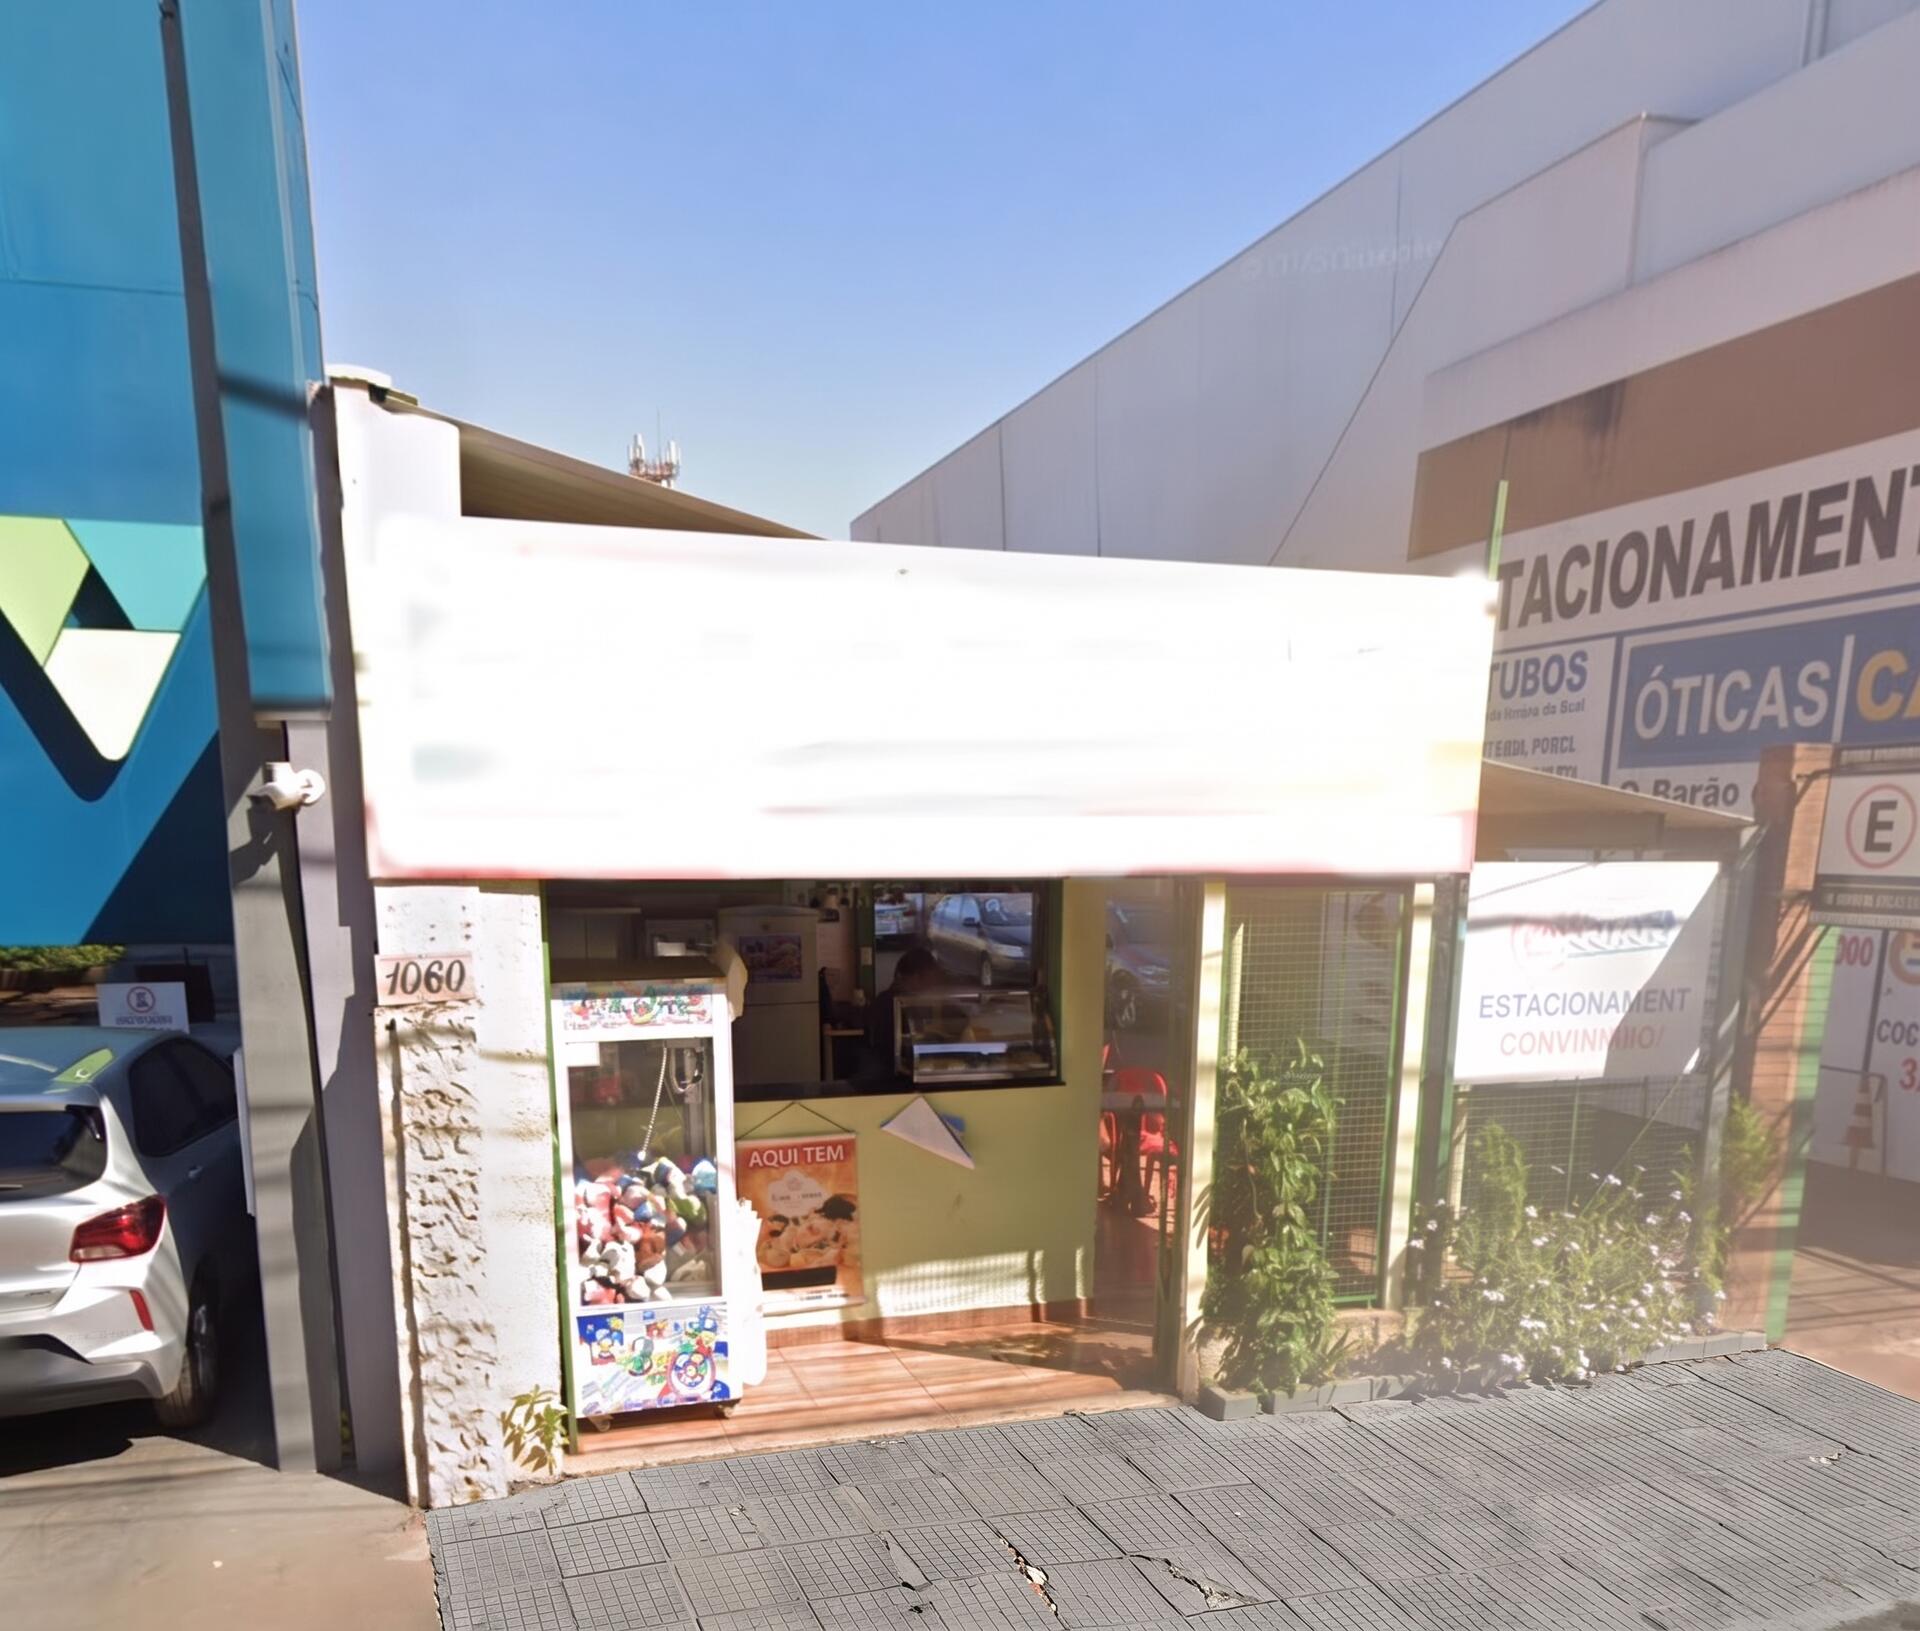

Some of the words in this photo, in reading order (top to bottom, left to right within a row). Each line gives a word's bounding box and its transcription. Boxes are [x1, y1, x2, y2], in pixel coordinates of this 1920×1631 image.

[1634, 660, 1831, 741] ÓTICAS
[1652, 776, 1740, 807] Barão
[1863, 800, 1898, 853] E
[385, 958, 467, 996] 1060
[1479, 987, 1692, 1019] ESTACIONAMENT
[748, 1148, 799, 1168] AQUI
[803, 1144, 845, 1164] TEM
